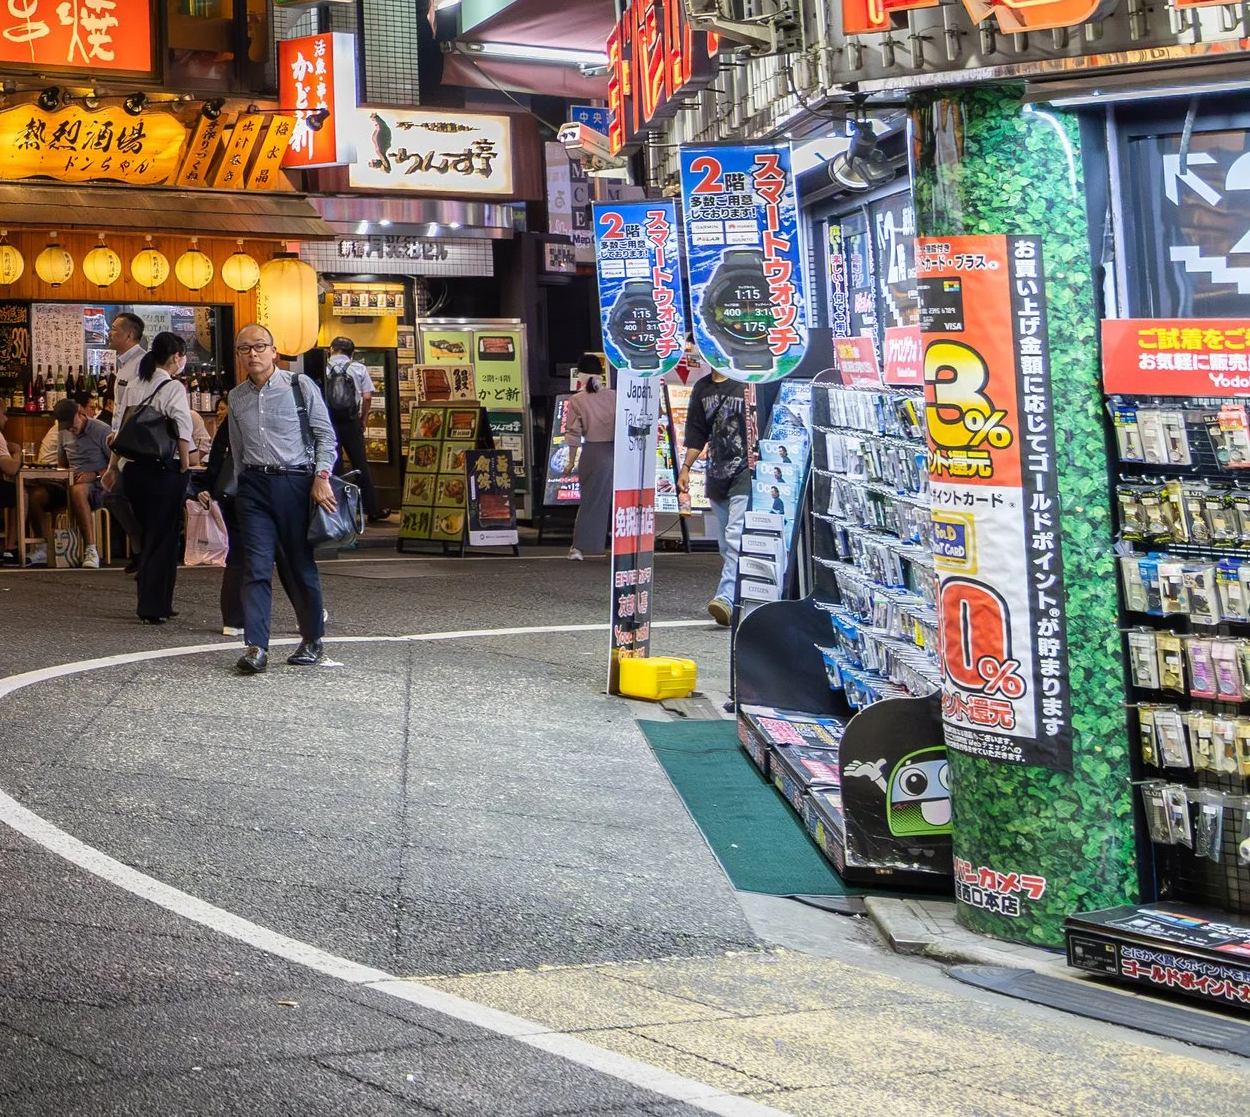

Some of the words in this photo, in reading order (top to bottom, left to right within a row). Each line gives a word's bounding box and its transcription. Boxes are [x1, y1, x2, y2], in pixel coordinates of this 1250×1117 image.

[288, 51, 314, 161] かど新
[17, 117, 146, 154] 熱烈酒場
[223, 122, 255, 184] 出汁巻き
[254, 121, 290, 184] 梅水晶
[64, 154, 149, 174] ドンちゃん
[690, 155, 746, 194] 2階
[690, 195, 754, 209] 多数ご用意
[599, 212, 641, 239] 2階
[600, 241, 647, 251] 多数ご用意
[752, 153, 800, 356] スマートウォッチ
[646, 209, 679, 360] スマートウォッチ
[734, 289, 761, 300] 1:15
[632, 309, 652, 319] 1:15
[723, 308, 741, 318] 400
[624, 323, 638, 332] 400
[743, 322, 766, 332] 175
[944, 322, 963, 331] VISA
[638, 334, 656, 343] 175
[477, 387, 521, 403] かど新
[751, 516, 772, 525] CITIZEN
